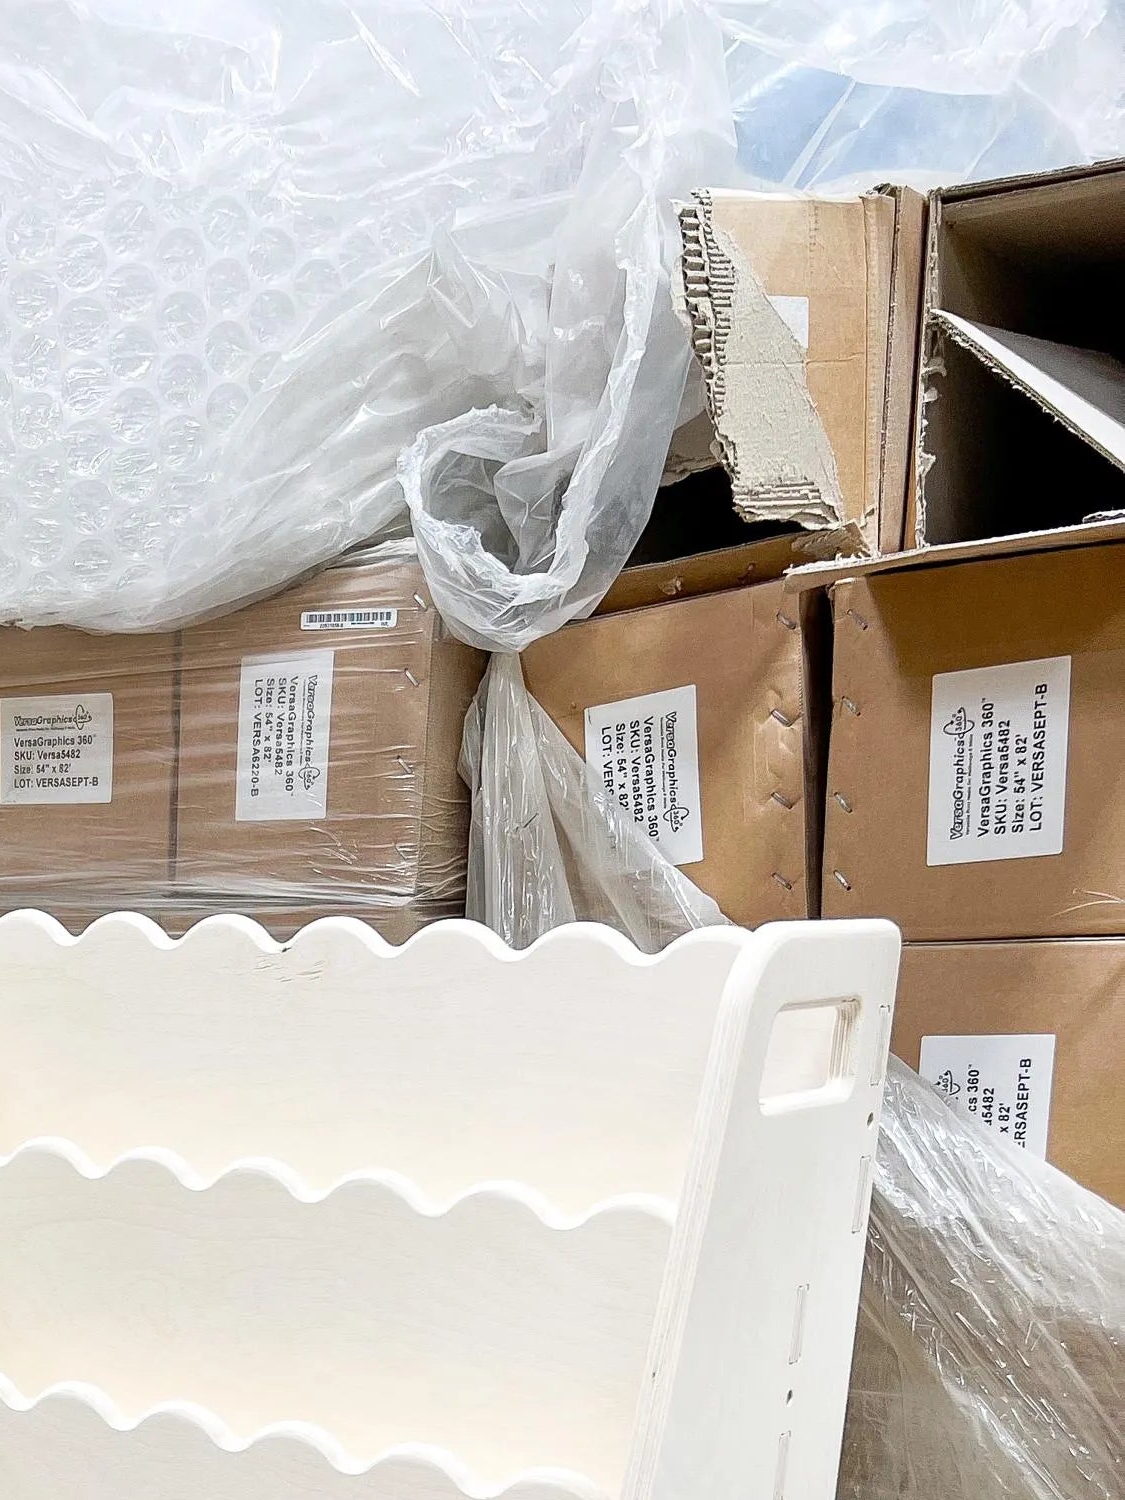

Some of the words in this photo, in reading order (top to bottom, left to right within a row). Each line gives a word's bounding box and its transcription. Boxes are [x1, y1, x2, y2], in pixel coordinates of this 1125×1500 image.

[254, 679, 264, 709] LOT:
[265, 678, 275, 708] Size:
[277, 678, 287, 709] SKU:
[14, 714, 73, 727] VersaGraphics
[287, 676, 299, 766] VersaGraphics
[305, 675, 318, 763] VersaGraphics
[14, 735, 75, 748] VersaGraphics
[251, 712, 262, 797] VERSA6220-B
[274, 713, 285, 776] Versa5482
[601, 727, 612, 757] LOT:
[616, 723, 625, 754] Size:
[629, 720, 641, 754] SKU:
[1031, 683, 1048, 793] VERSASEPT-B
[14, 751, 35, 761] SKU:
[37, 749, 81, 760] Versa5482
[14, 765, 33, 774] Size:
[643, 716, 657, 811] VersaGraphics
[665, 712, 678, 805] VersaGraphics
[996, 719, 1011, 795] Versa5482
[1017, 758, 1026, 766] x
[14, 779, 34, 788] LOT:
[36, 777, 98, 788] VERSASEPT-B
[631, 756, 644, 823] Versa5482
[950, 740, 967, 840] VersaGraphics
[977, 732, 994, 838] VersaGraphics
[994, 799, 1007, 835] SKU:
[1012, 799, 1024, 834] Size:
[1029, 796, 1043, 832] LOT:
